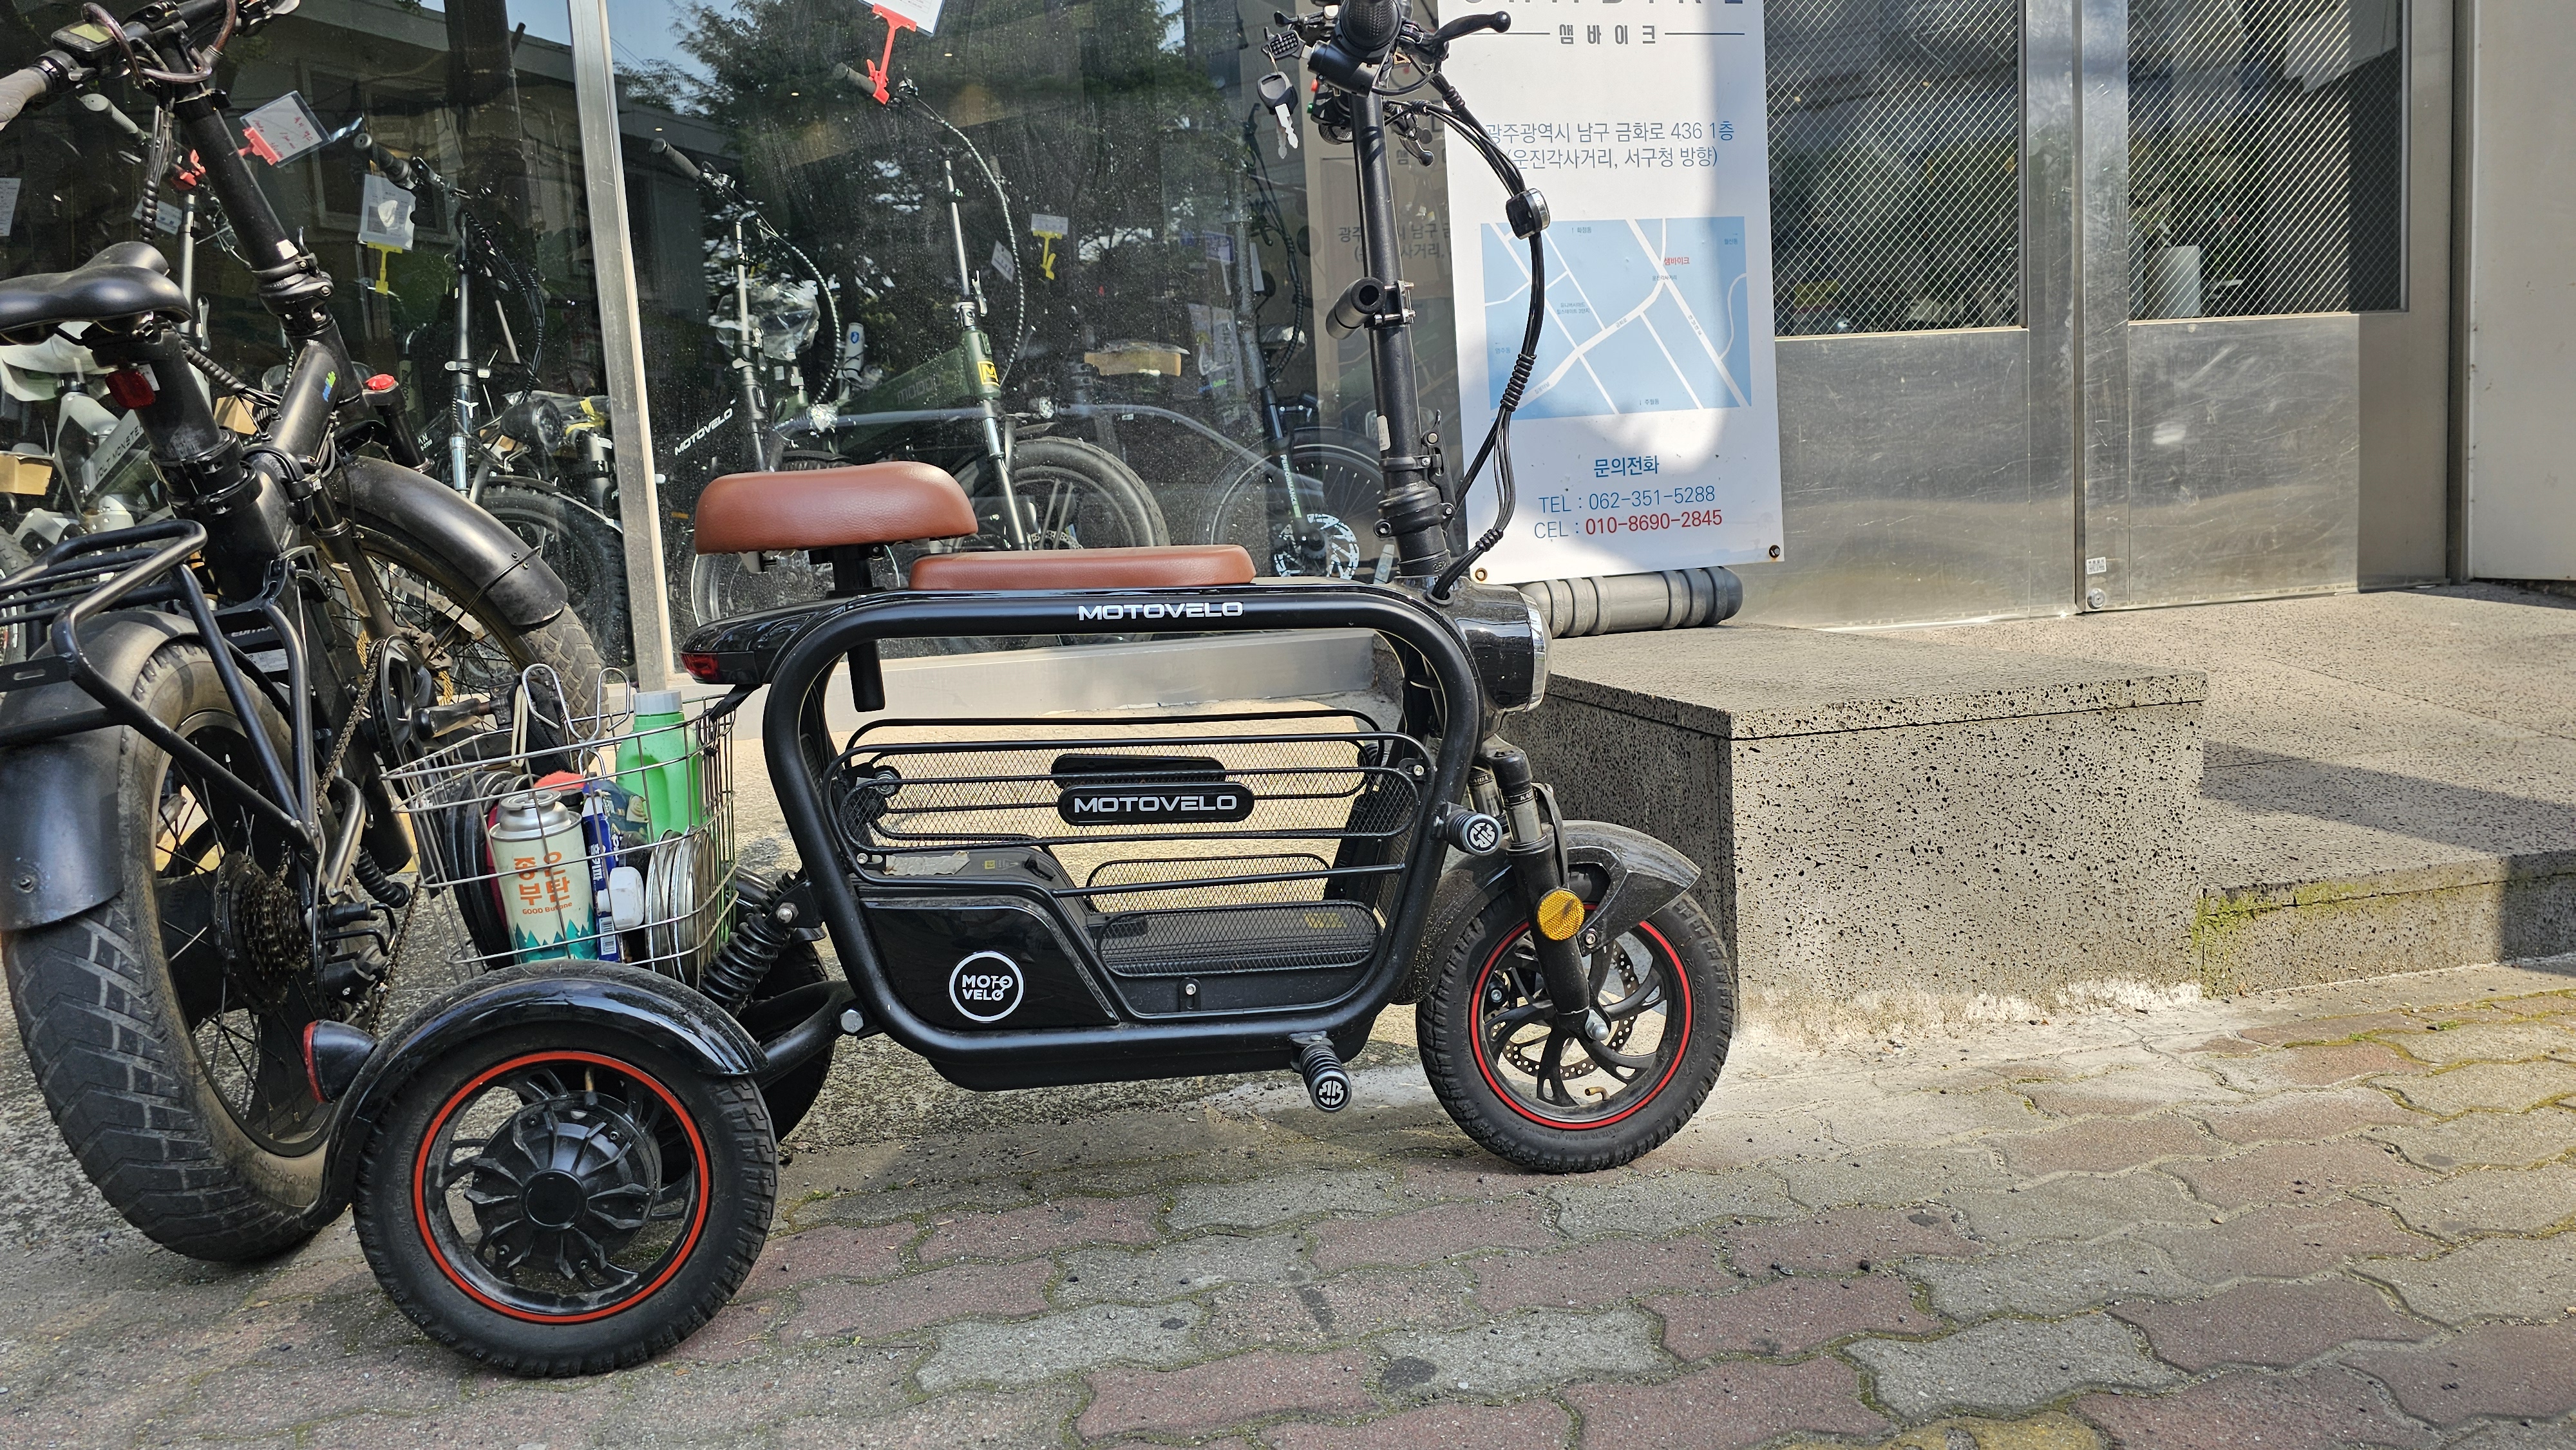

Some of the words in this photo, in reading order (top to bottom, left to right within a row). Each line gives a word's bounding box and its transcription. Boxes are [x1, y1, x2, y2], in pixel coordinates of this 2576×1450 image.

[1559, 24, 1656, 45] 샘바이크
[1485, 122, 1570, 144] 광주광역시
[1577, 122, 1609, 143] 남구
[1615, 122, 1665, 142] 금화로
[1671, 122, 1703, 140] 436
[1709, 120, 1734, 141] 1층
[1625, 146, 1674, 168] 서구청
[1680, 146, 1718, 167] 방향)
[1664, 257, 1690, 265] 샘바이크
[674, 408, 733, 456] MOTOVELO
[95, 457, 111, 482] VOLT
[111, 425, 142, 463] MONSTE
[1594, 455, 1660, 478] 문의전화
[1539, 496, 1571, 513] TEL
[1589, 485, 1716, 510] 062-351-5288
[1534, 520, 1569, 539] CEL
[1586, 509, 1723, 535] 010-8690-2845
[1078, 601, 1244, 621] MOTOVELO
[1074, 795, 1237, 813] MOTOVELO
[514, 851, 567, 881] 좋은
[589, 843, 603, 881] 홈키파
[518, 876, 571, 906] 부탄
[961, 974, 1014, 990] MOTO
[962, 988, 1004, 1001] VELO
